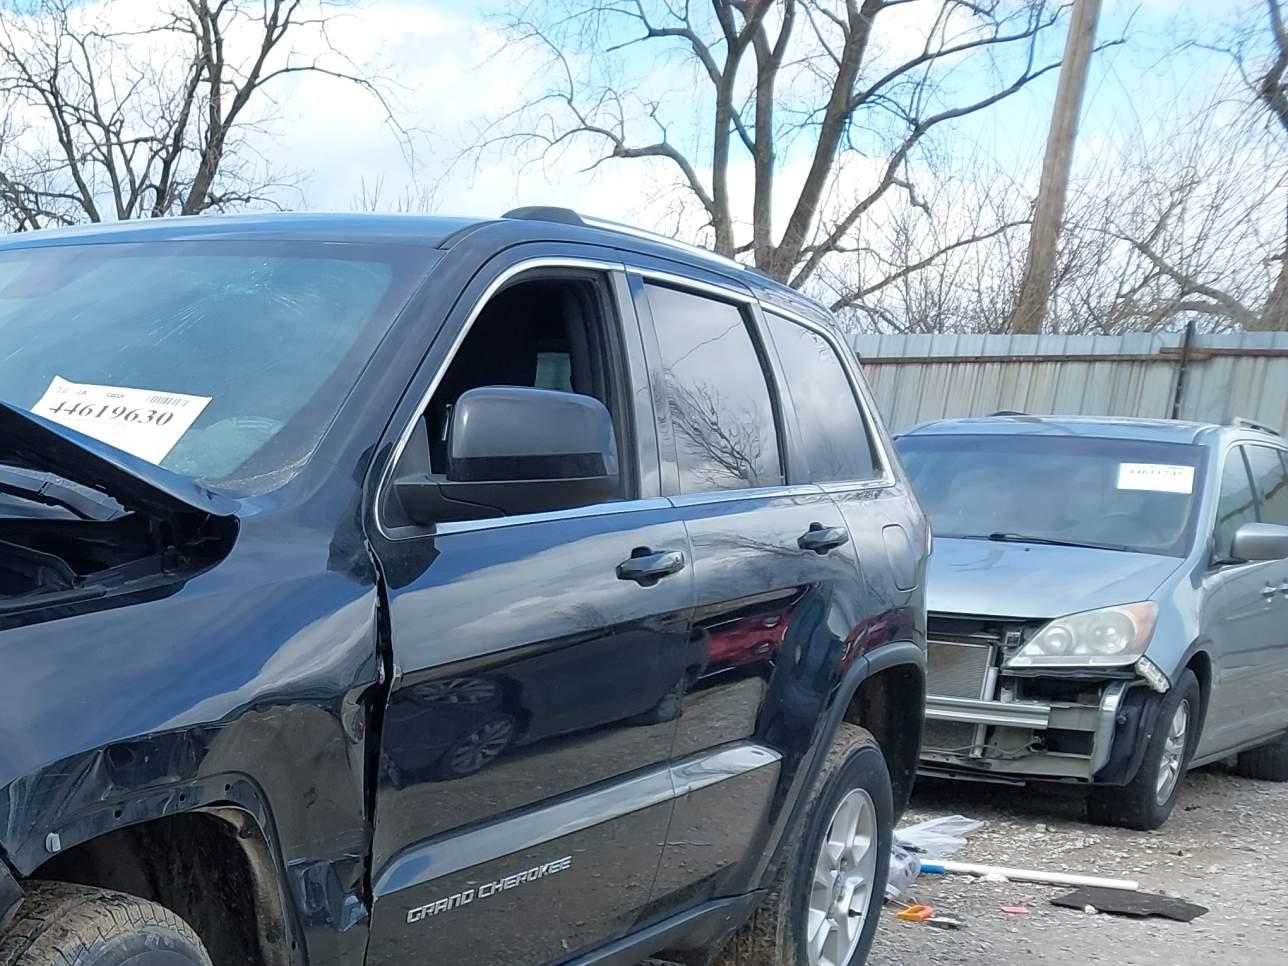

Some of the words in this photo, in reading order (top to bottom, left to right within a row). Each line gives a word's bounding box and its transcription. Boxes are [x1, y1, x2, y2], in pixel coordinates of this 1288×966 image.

[49, 400, 174, 426] 44619630
[406, 889, 475, 924] GRAND
[478, 855, 573, 899] CHEROKEE
